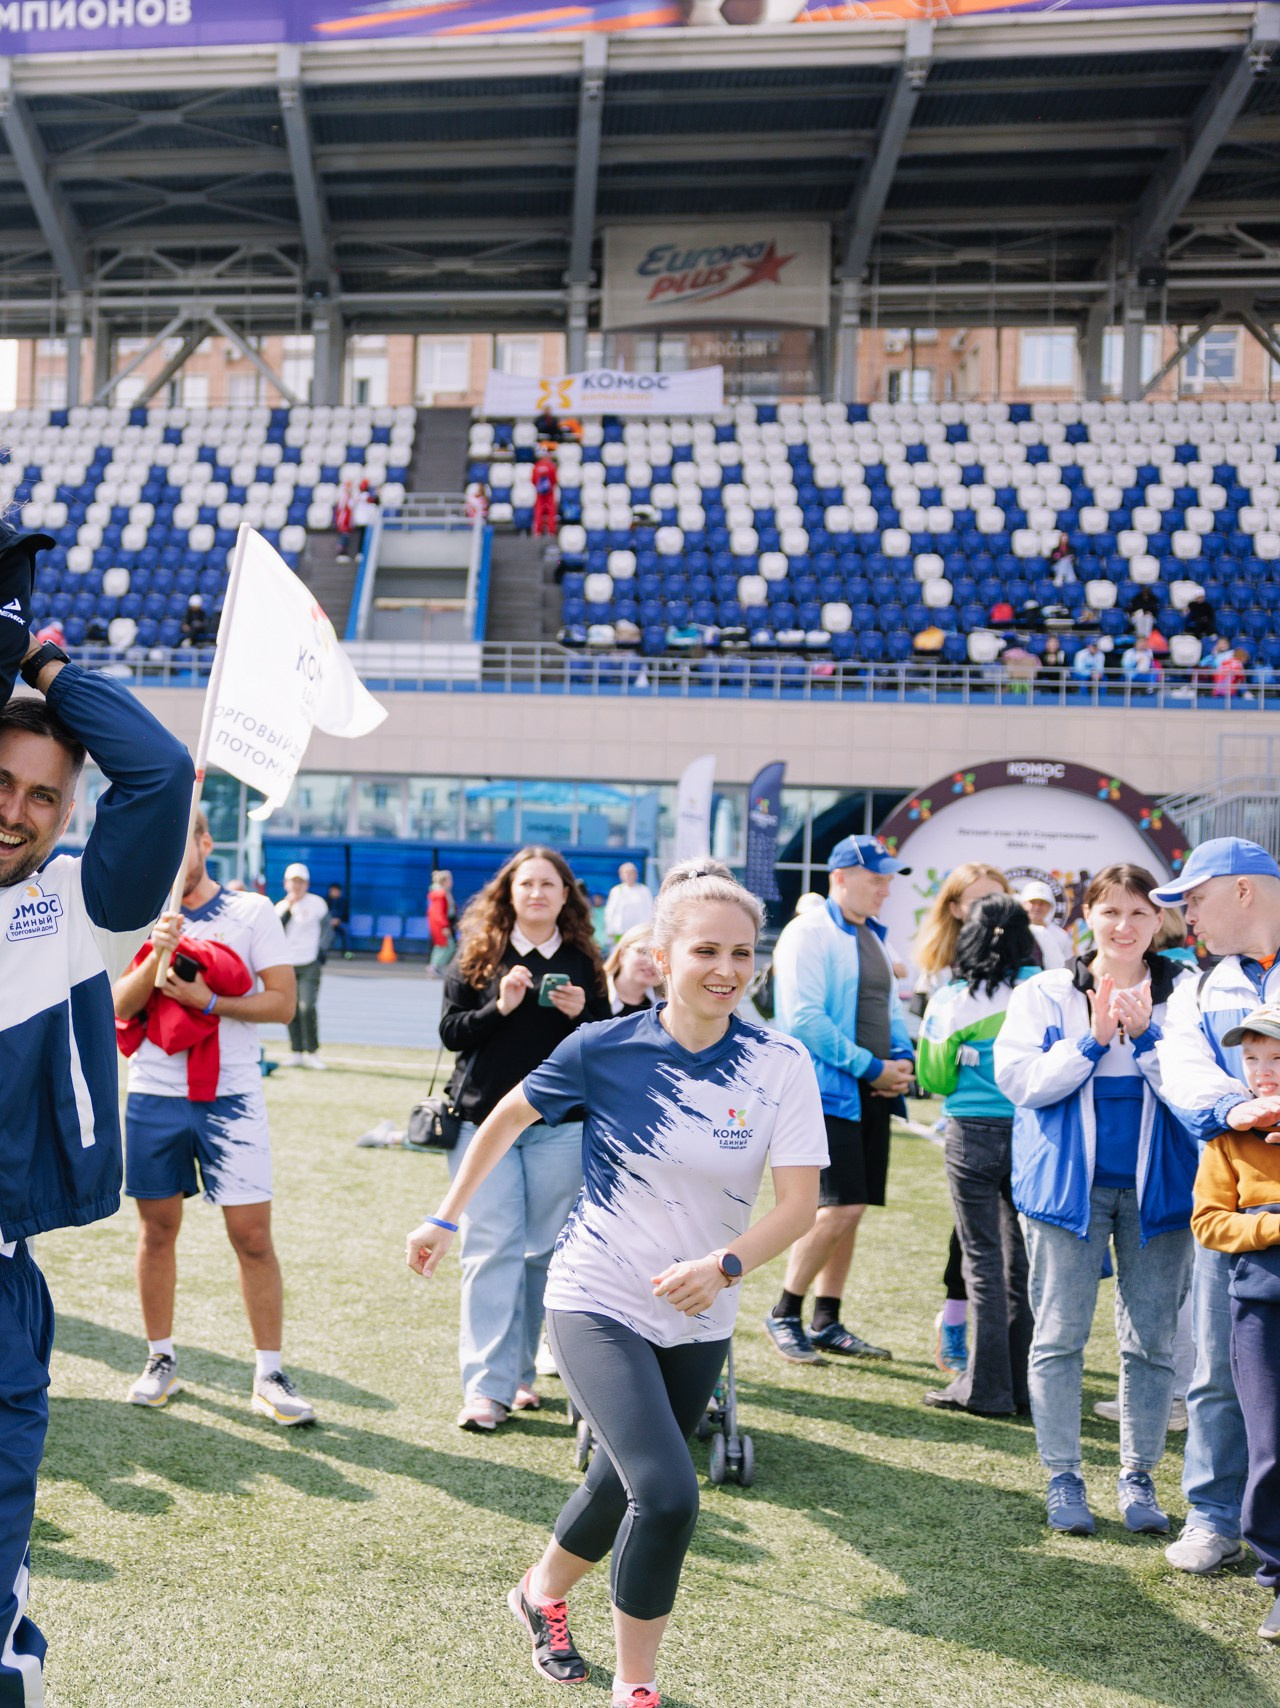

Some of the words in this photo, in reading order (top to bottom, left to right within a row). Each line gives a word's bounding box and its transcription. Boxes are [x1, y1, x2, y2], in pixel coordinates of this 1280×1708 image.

[583, 373, 669, 390] КОМОС
[213, 704, 293, 752] ОРГОВЫЙ
[1007, 762, 1065, 778] КОМОС
[9, 915, 53, 931] ЕДИНЫЙ
[11, 927, 40, 937] ТОРГОВЫЙ
[41, 924, 54, 932] ДОМ
[713, 1129, 753, 1139] КОМОС
